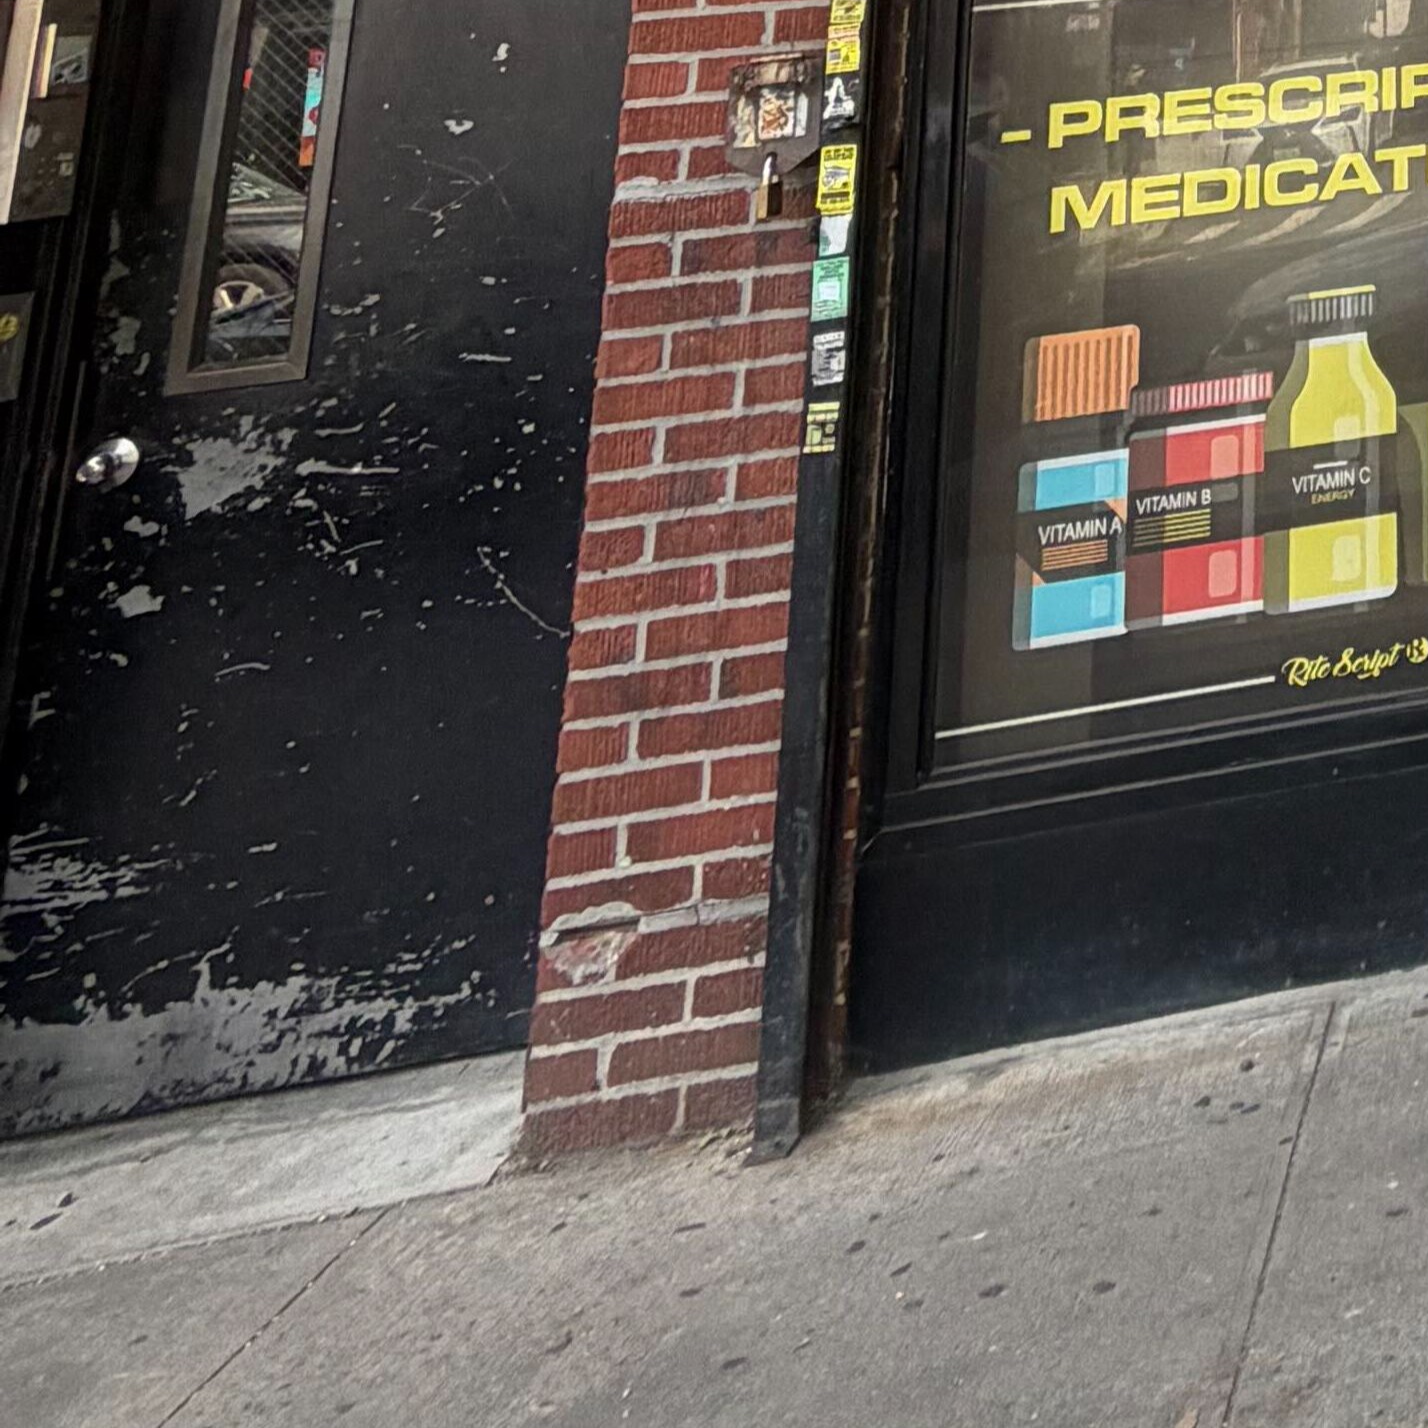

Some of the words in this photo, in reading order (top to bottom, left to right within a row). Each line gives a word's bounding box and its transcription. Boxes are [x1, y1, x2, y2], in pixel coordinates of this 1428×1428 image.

[1292, 468, 1356, 495] VITAMIN
[1358, 465, 1371, 484] C
[1136, 491, 1199, 515] VITAMIN
[1200, 488, 1212, 505] B
[1310, 488, 1355, 505] ENERGY
[1038, 518, 1108, 546] VITAMIN
[1107, 516, 1123, 535] A
[1281, 654, 1332, 687] Rite
[1333, 641, 1404, 681] Script
